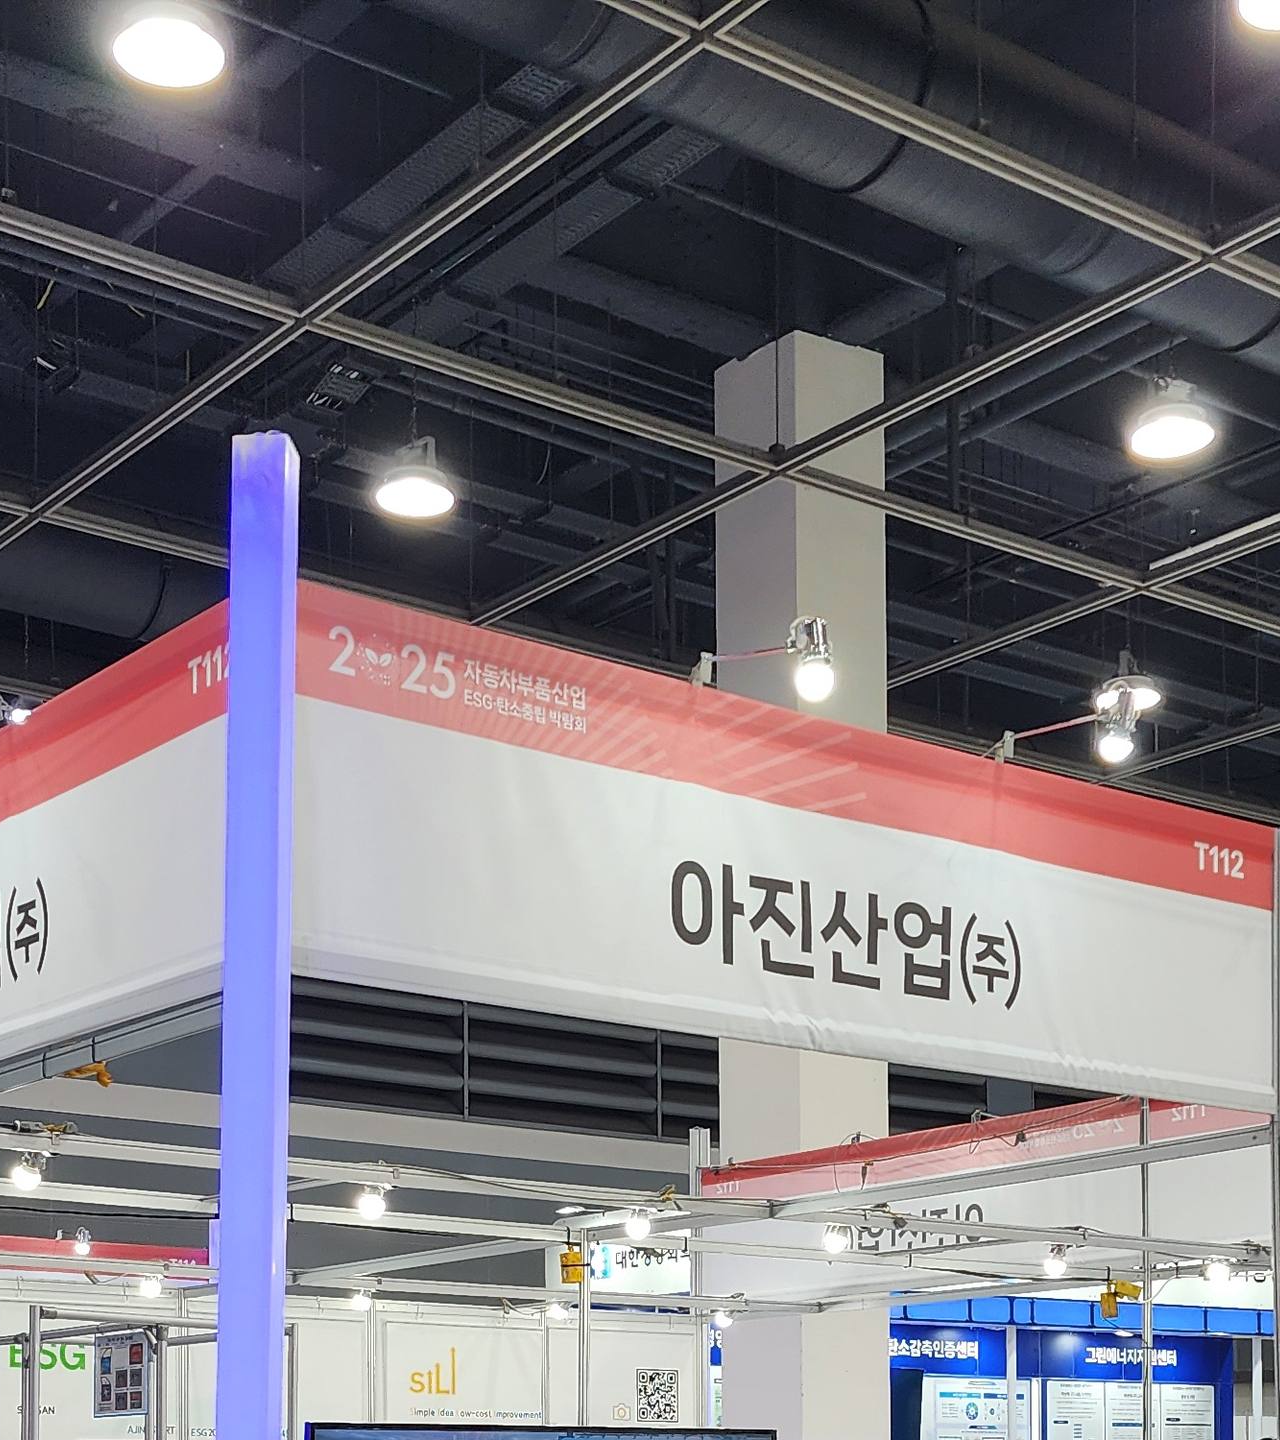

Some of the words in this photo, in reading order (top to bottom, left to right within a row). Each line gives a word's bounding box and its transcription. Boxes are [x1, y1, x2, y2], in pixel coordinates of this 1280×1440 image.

[463, 659, 587, 711] 자동차부품산업
[549, 709, 587, 734] 박람회
[1194, 841, 1245, 879] T112
[671, 861, 1021, 1010] 아진산업(주)
